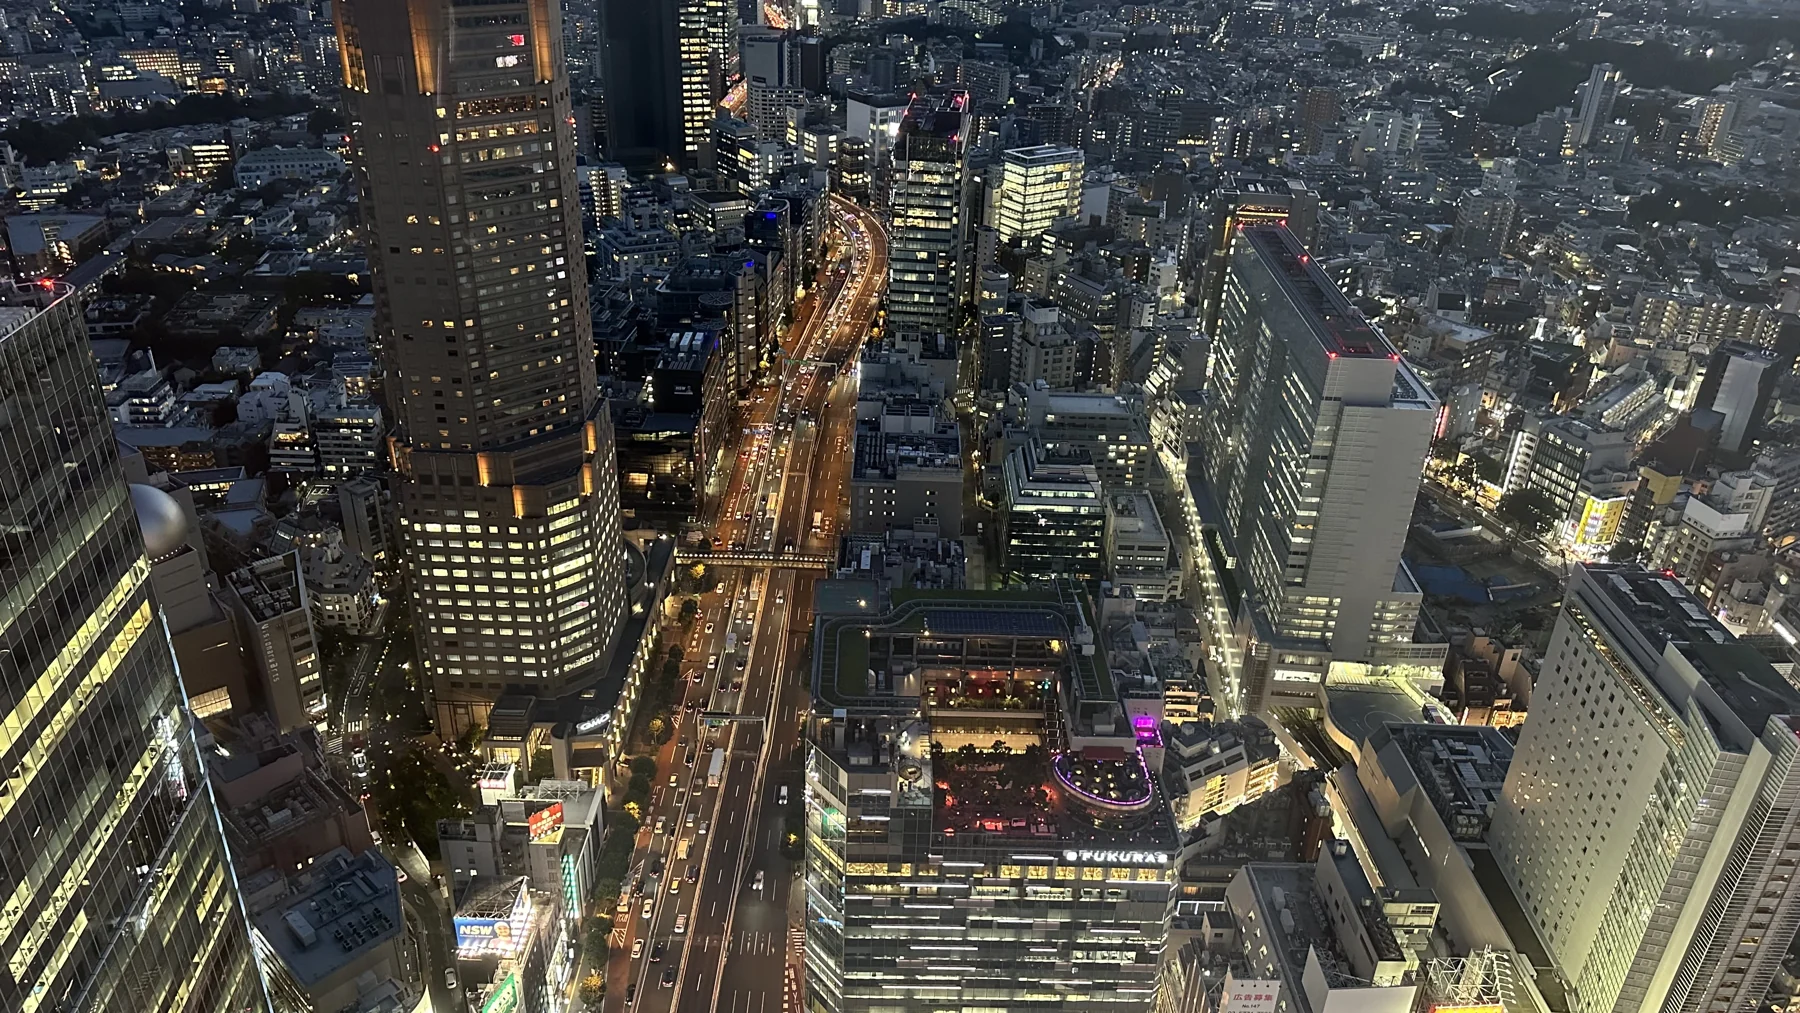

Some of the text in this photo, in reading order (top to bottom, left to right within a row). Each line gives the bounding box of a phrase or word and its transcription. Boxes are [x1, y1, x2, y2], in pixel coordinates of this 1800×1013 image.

[1082, 851, 1168, 863] FUKURAS
[460, 925, 493, 935] NSW
[1233, 993, 1273, 1002] 広告募集
